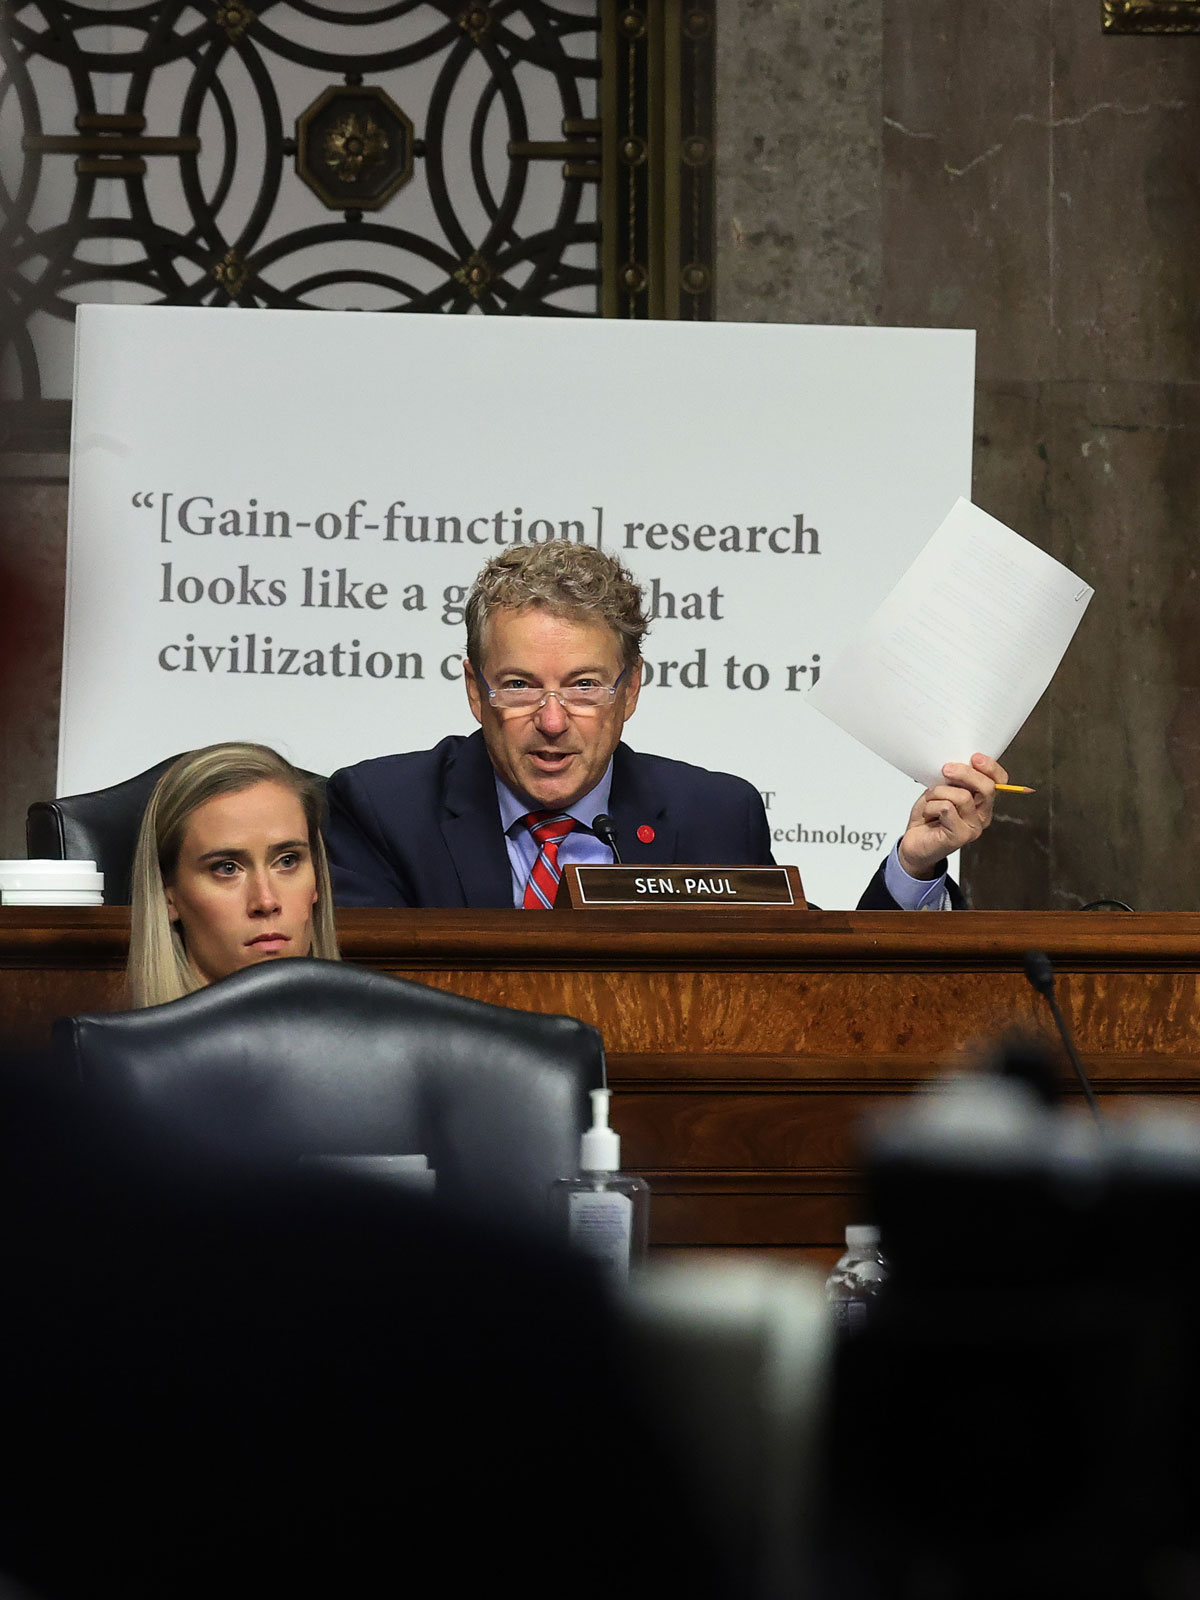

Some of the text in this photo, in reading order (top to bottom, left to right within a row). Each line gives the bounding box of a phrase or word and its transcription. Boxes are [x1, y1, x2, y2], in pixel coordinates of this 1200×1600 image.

[623, 514, 821, 555] research
[159, 562, 287, 607] looks
[300, 567, 388, 610] like
[402, 583, 427, 611] a
[641, 578, 724, 621] hat
[158, 633, 425, 680] civilization
[724, 655, 770, 691] to
[770, 823, 888, 852] echnology
[634, 878, 737, 895] SEN. PAUL
